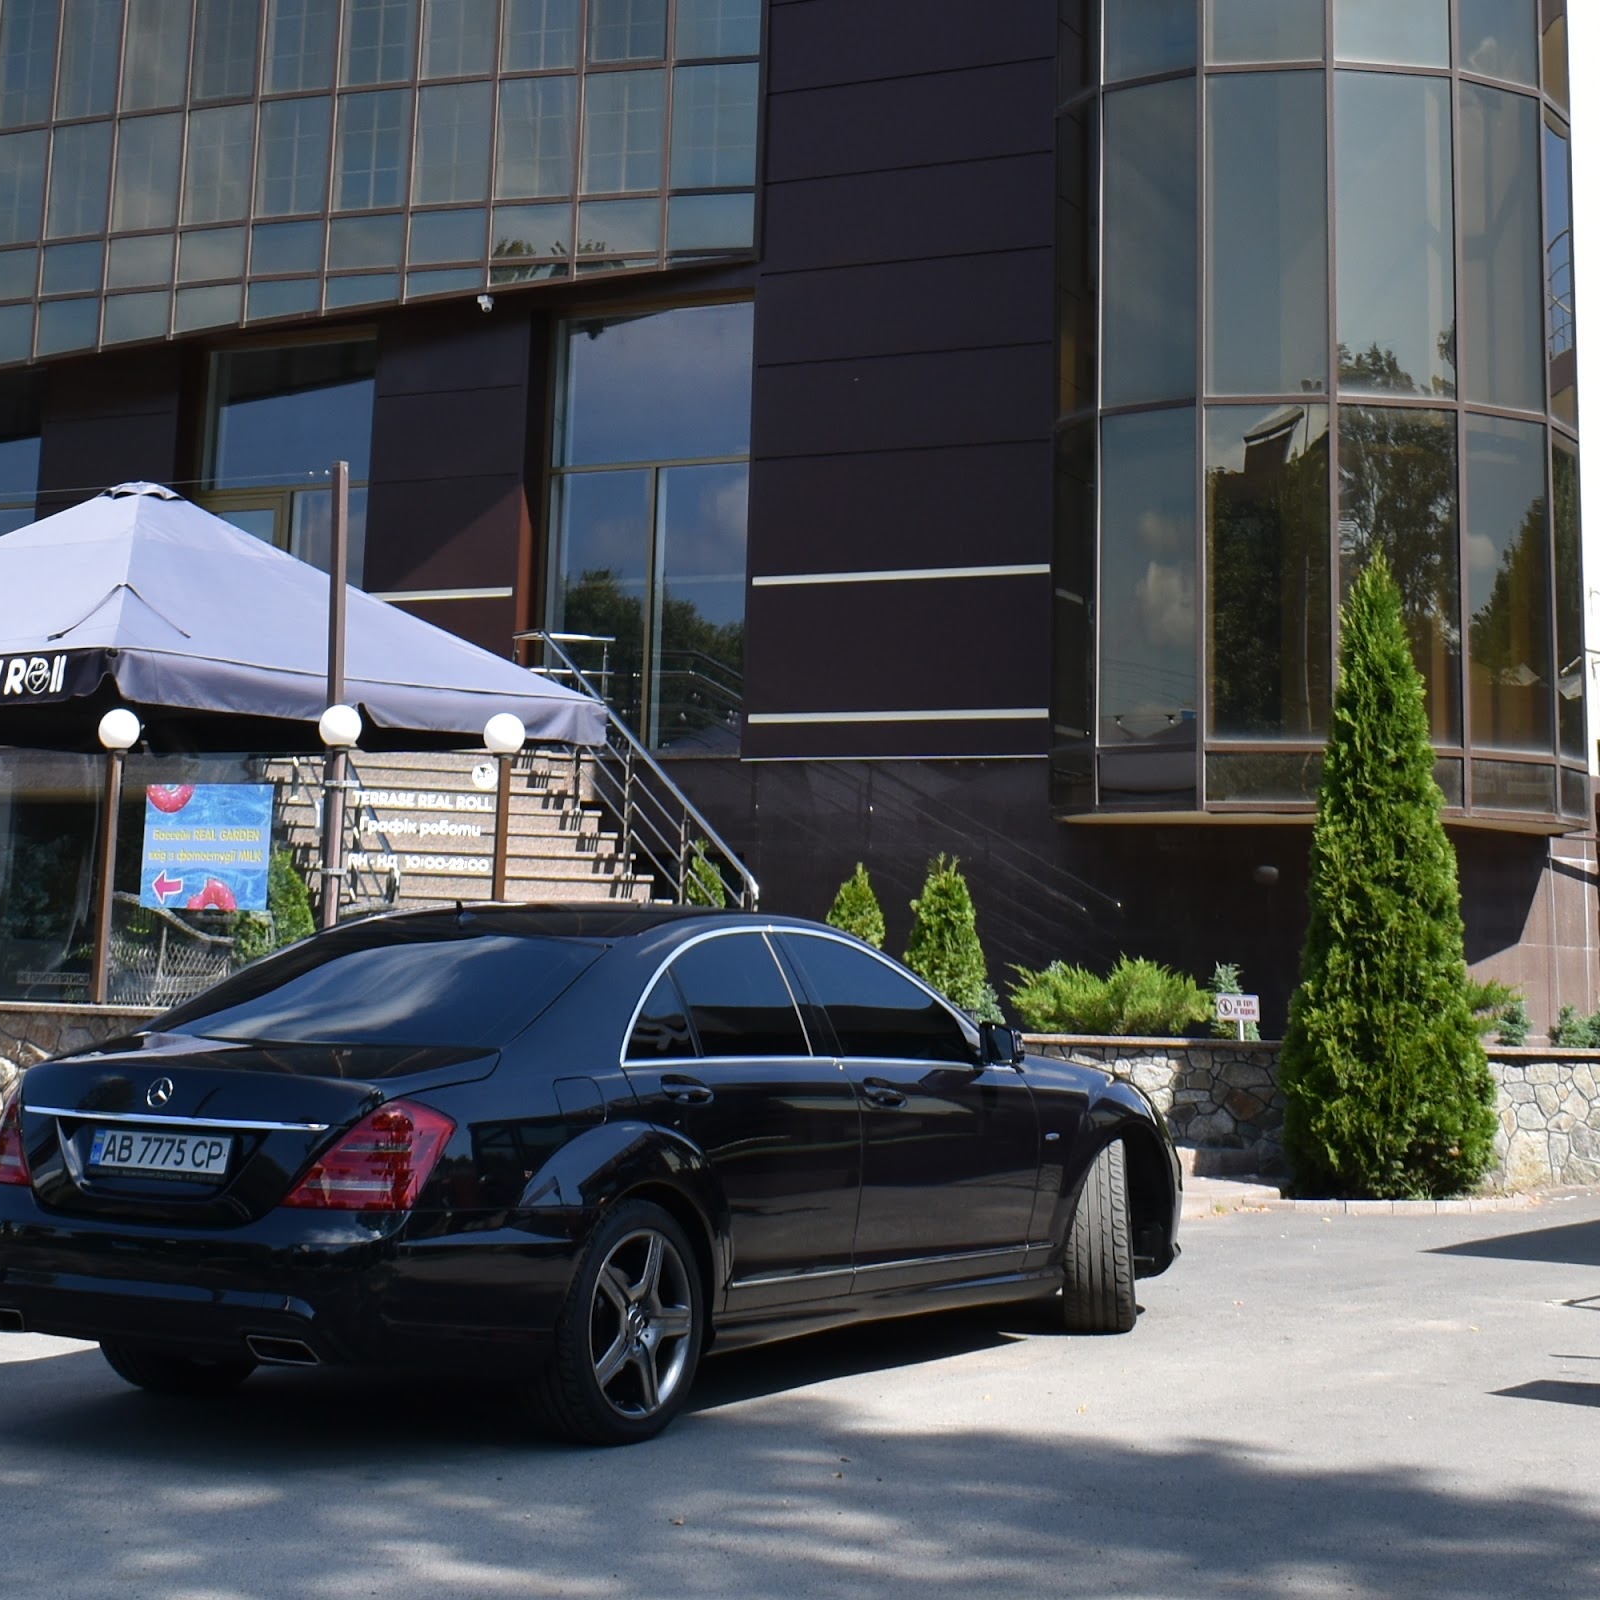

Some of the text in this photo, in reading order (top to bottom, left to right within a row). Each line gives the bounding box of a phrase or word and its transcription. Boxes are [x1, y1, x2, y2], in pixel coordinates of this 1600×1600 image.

[417, 794, 453, 808] REAL
[455, 795, 493, 811] ROLL
[194, 828, 217, 840] REAL
[221, 828, 261, 840] GARDEN
[359, 816, 482, 837] Графік роботи
[102, 1135, 223, 1169] AB 7775 CP
